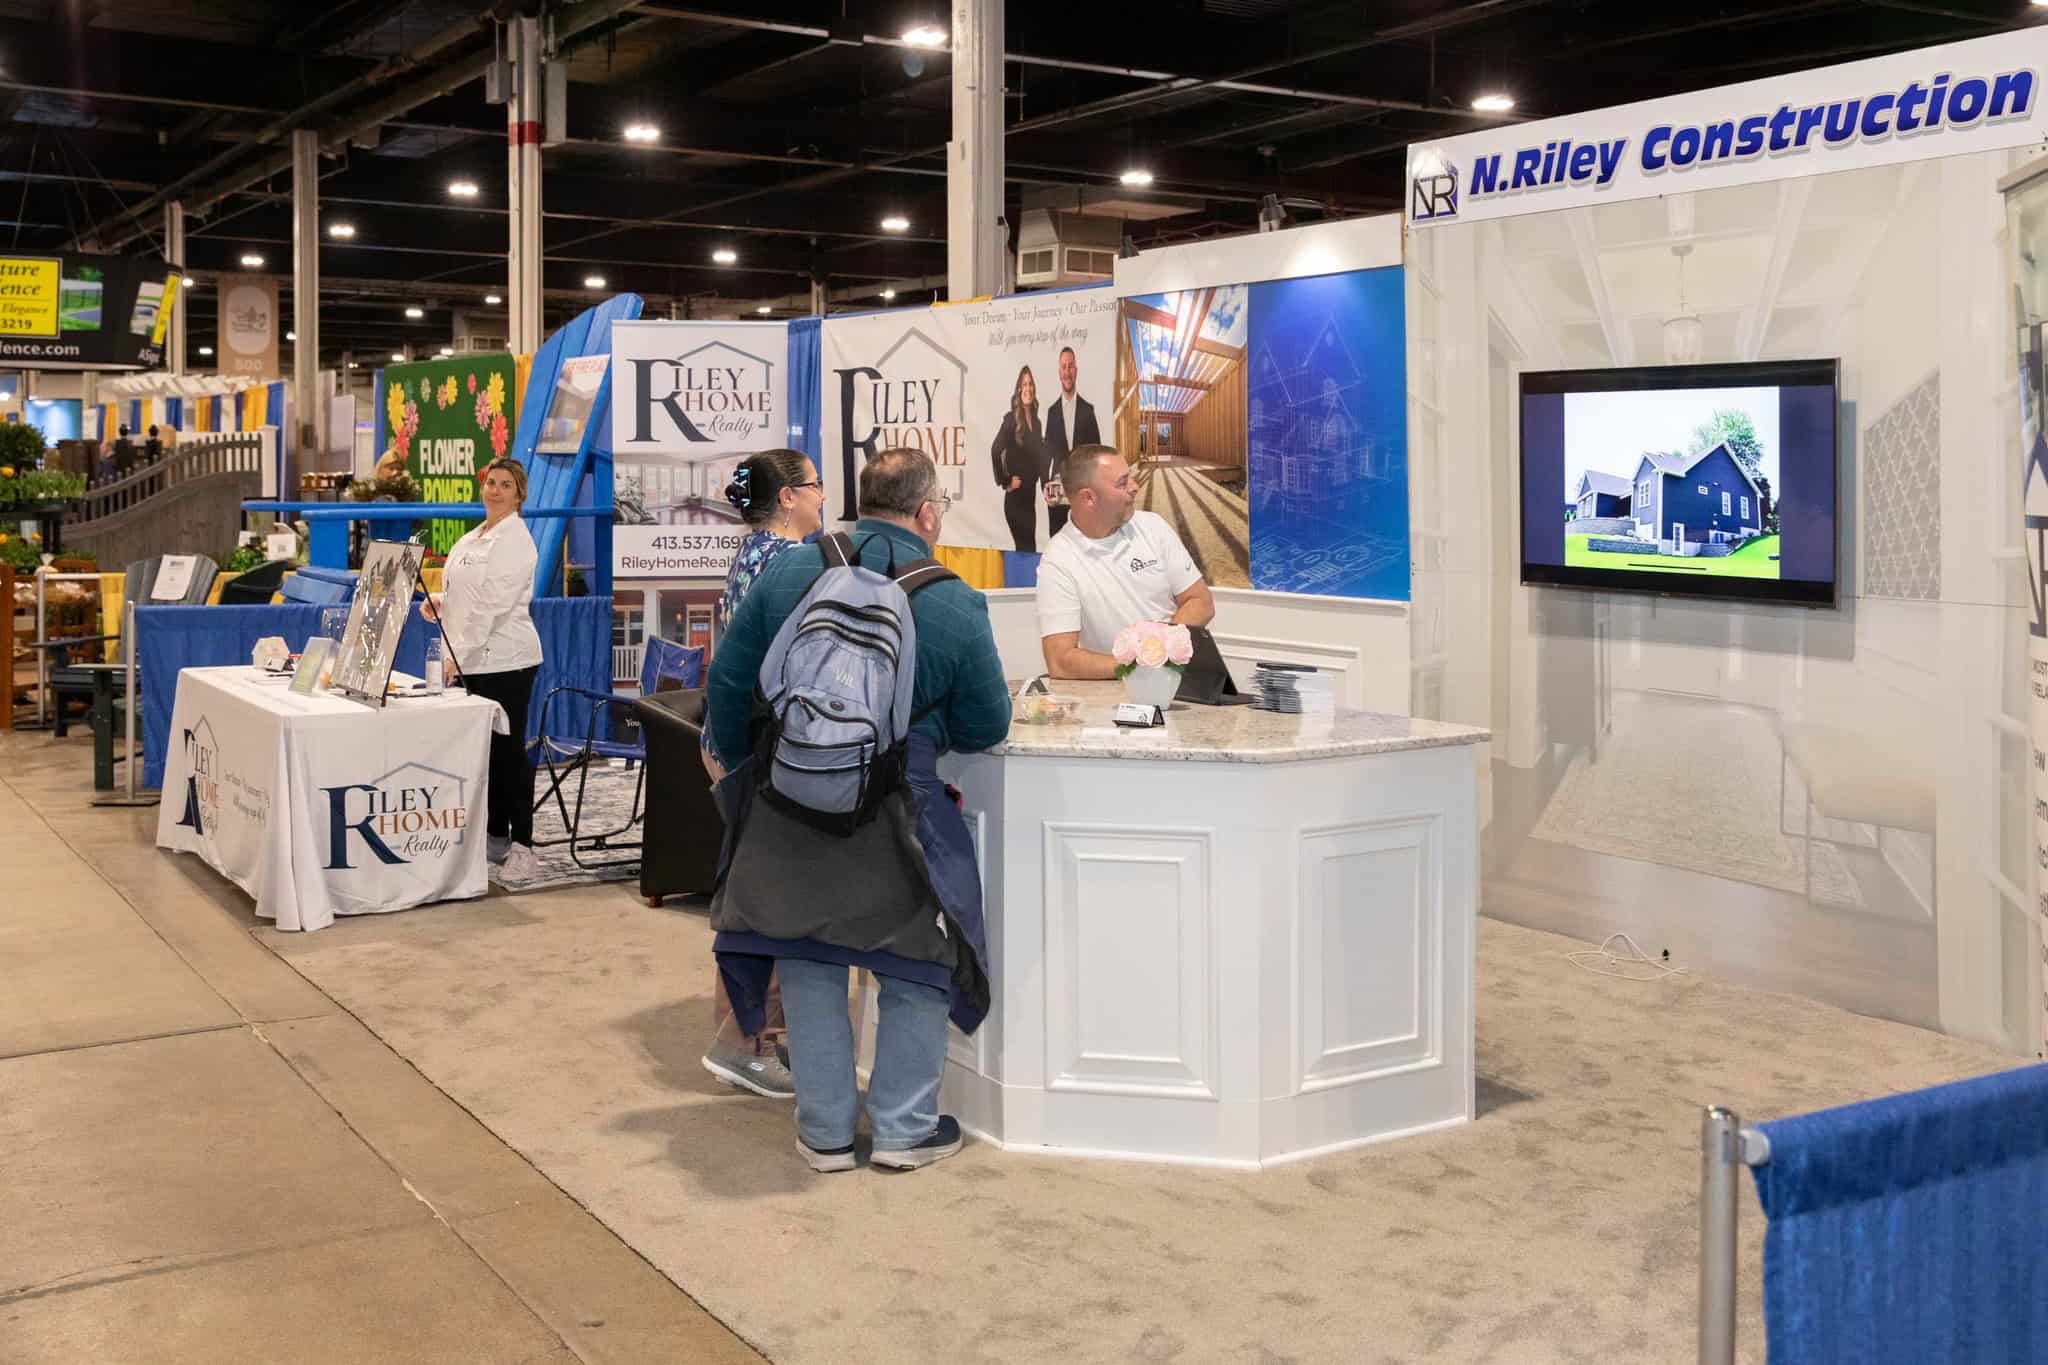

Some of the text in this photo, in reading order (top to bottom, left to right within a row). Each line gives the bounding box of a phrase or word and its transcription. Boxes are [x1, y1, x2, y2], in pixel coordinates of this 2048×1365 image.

[1469, 68, 2034, 196] N.Riley Construction
[684, 392, 772, 412] HOME
[707, 414, 755, 440] Realty
[419, 438, 476, 475] FLOWER
[423, 478, 473, 504] POWER
[651, 536, 744, 550] 413.537.169
[621, 556, 732, 571] RileyHomeReal
[379, 808, 466, 835] HOME
[403, 834, 450, 857] Realty
